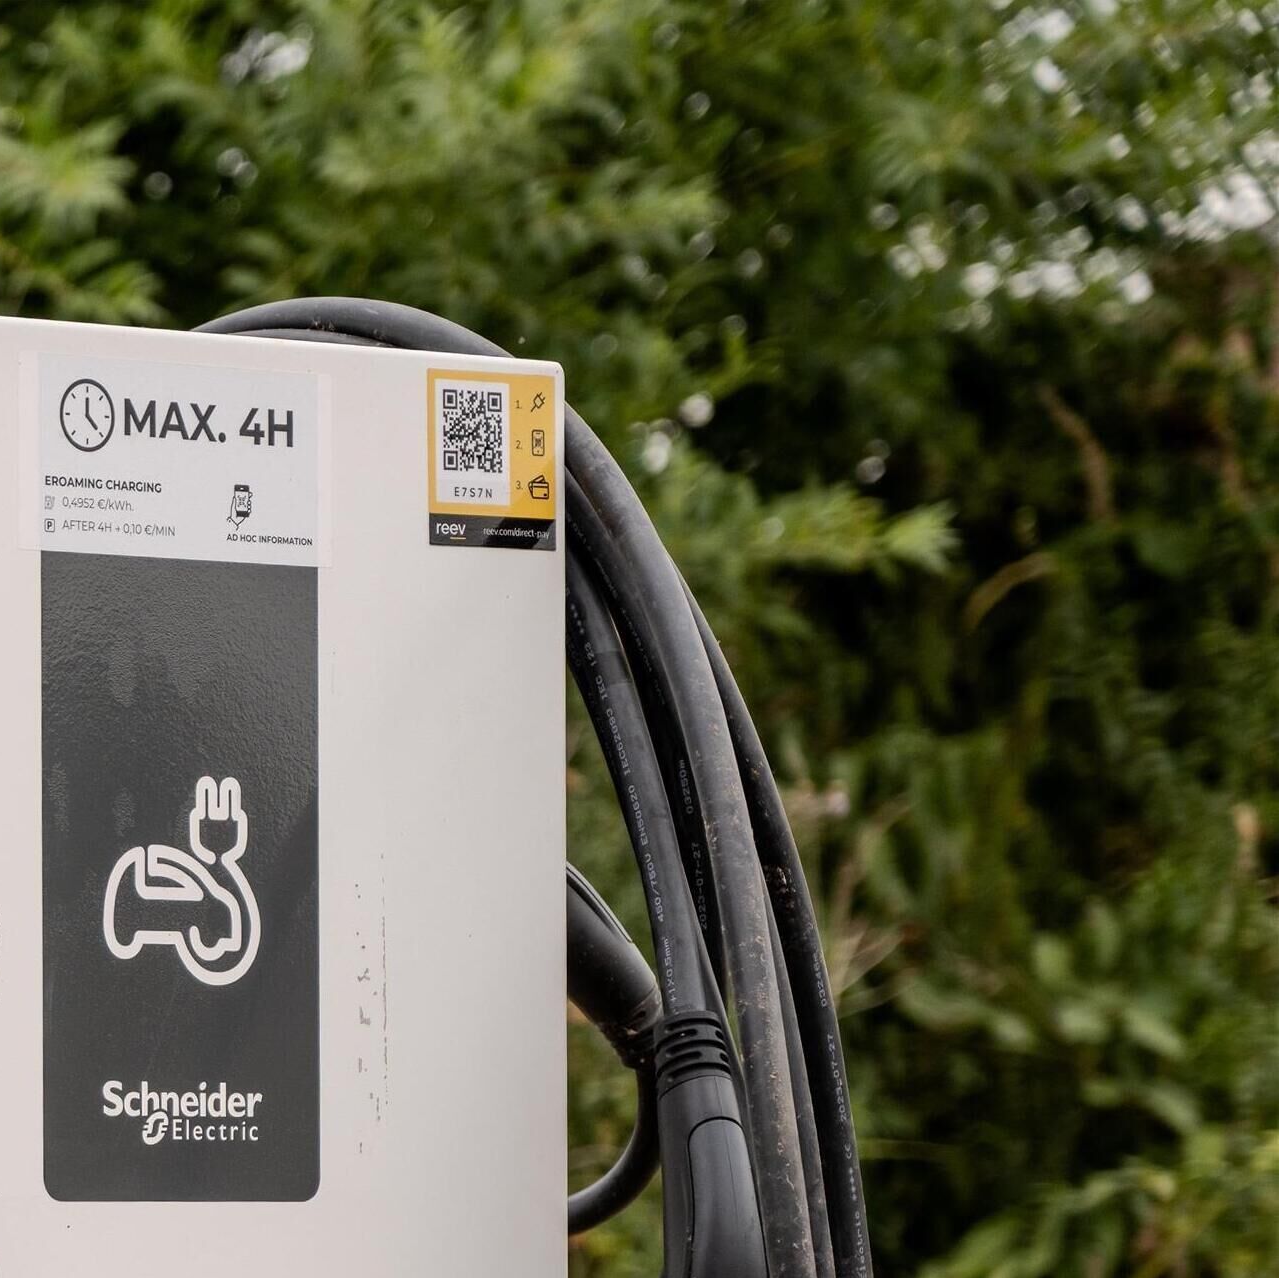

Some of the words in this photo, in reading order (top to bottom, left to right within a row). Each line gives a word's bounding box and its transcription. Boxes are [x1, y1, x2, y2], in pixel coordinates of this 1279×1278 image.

[515, 400, 523, 409] 1.
[123, 398, 227, 443] MAX.
[239, 407, 293, 448] 4H
[516, 440, 523, 450] 2.
[44, 475, 103, 490] EROAMING
[105, 480, 162, 493] CHARGING
[516, 480, 523, 490] 3.
[454, 486, 493, 499] E7S7N
[62, 496, 95, 509] 0,4952
[62, 520, 95, 532] AFTER
[97, 522, 112, 533] 4H
[144, 524, 176, 537] €/MIN
[435, 521, 466, 536] reev
[483, 526, 550, 540] reev.com/direct-pay
[227, 533, 239, 542] AD
[240, 534, 257, 543] HOC
[259, 535, 313, 547] INFORMATION
[595, 675, 608, 700] IEC
[628, 785, 648, 846] EN50620
[102, 1080, 263, 1117] Schneider
[172, 1119, 259, 1141] Electric
